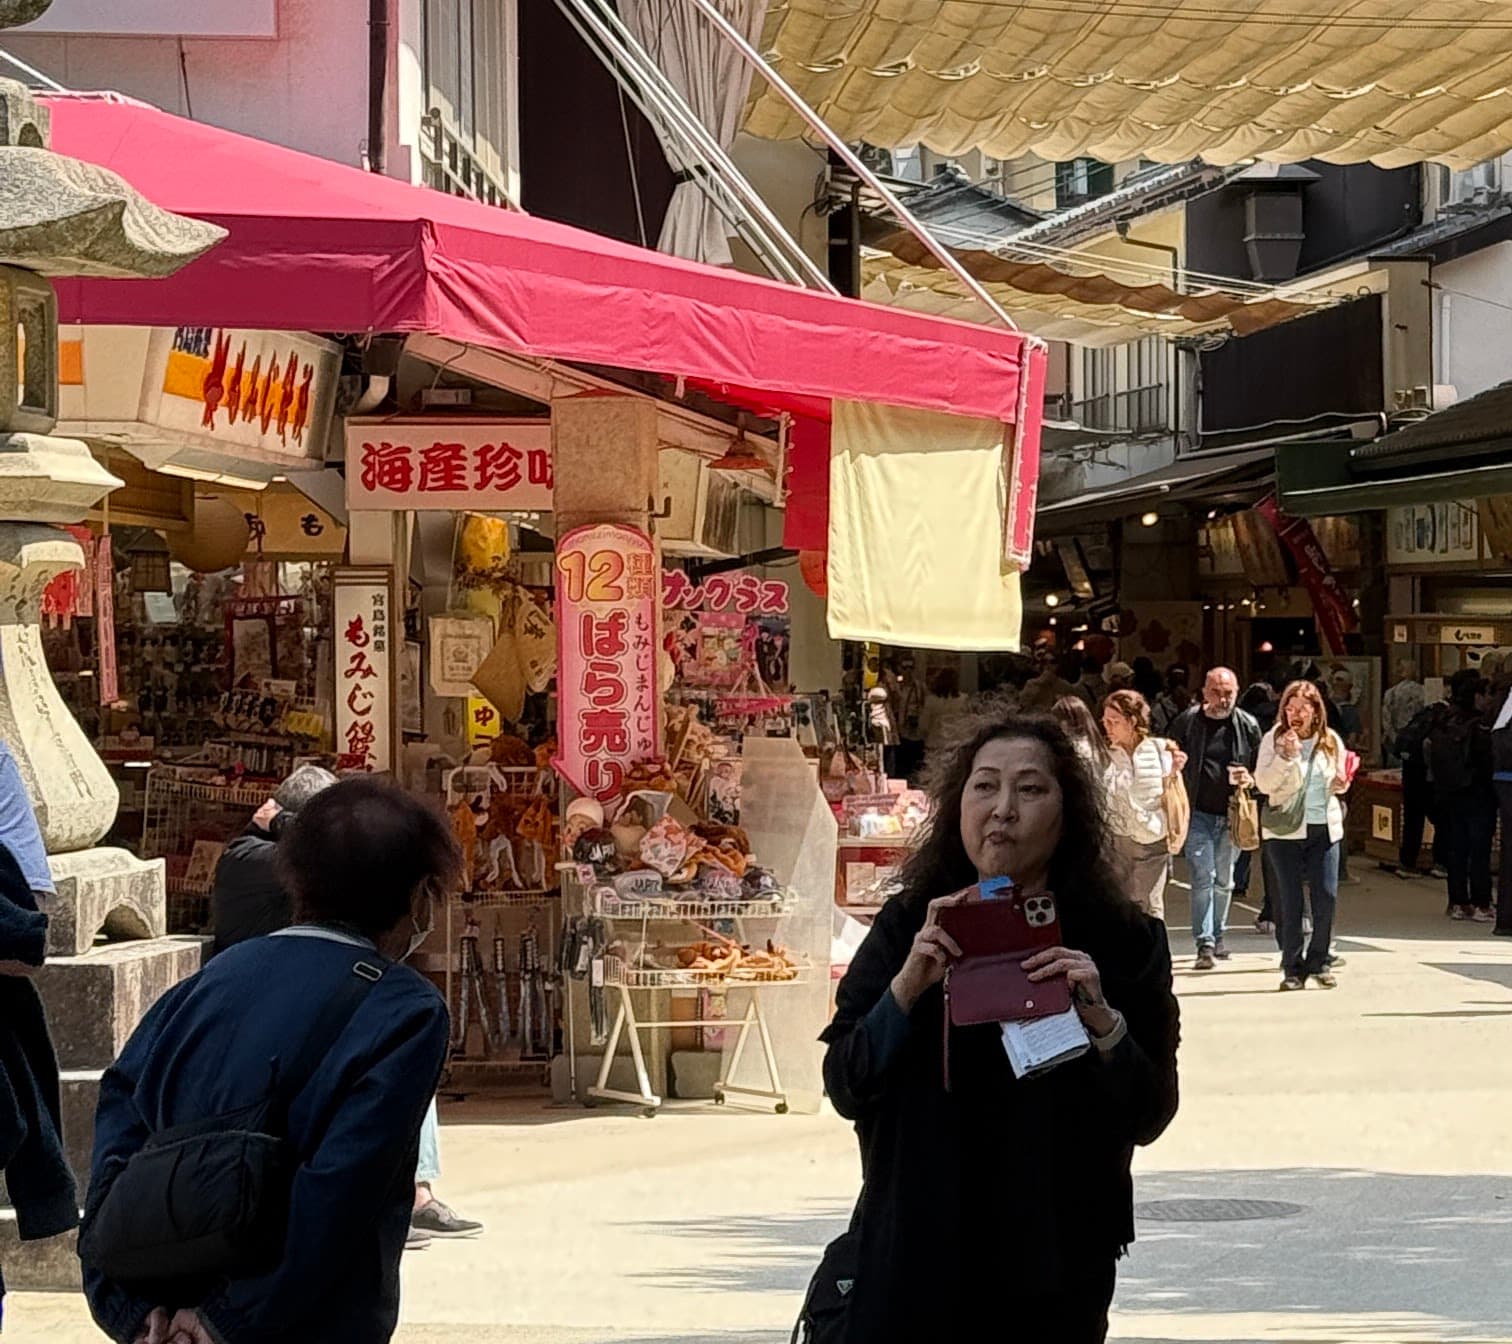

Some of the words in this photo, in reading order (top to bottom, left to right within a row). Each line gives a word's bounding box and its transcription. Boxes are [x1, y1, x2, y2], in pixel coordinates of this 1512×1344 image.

[581, 609, 628, 802] ばら売り
[632, 612, 653, 751] もみじまんじゅ
